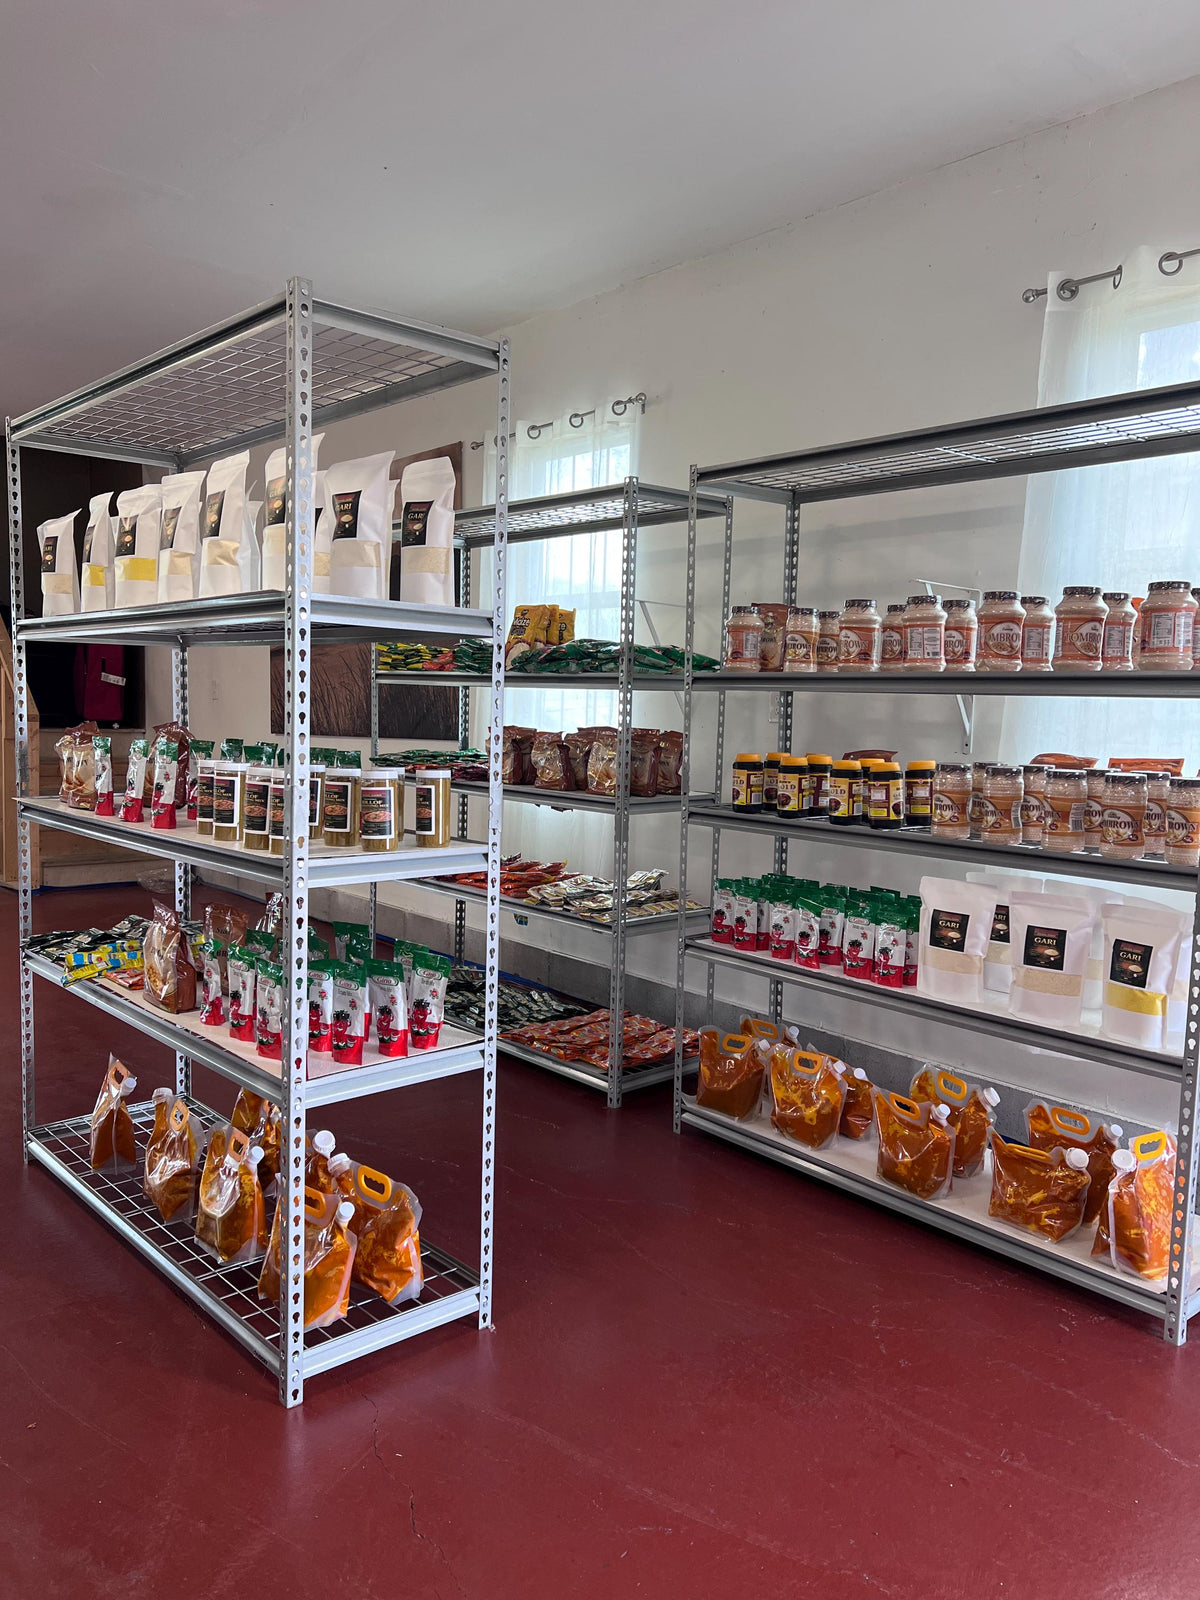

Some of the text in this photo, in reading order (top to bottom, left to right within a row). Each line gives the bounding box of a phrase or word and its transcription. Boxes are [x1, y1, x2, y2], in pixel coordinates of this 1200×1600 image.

[938, 920, 960, 929] GARI
[1034, 937, 1057, 946] GARI
[1119, 951, 1143, 962] GARI
[309, 971, 324, 979] Gino
[422, 970, 438, 978] Gino
[338, 979, 353, 988] Gino
[377, 977, 393, 985] Gino
